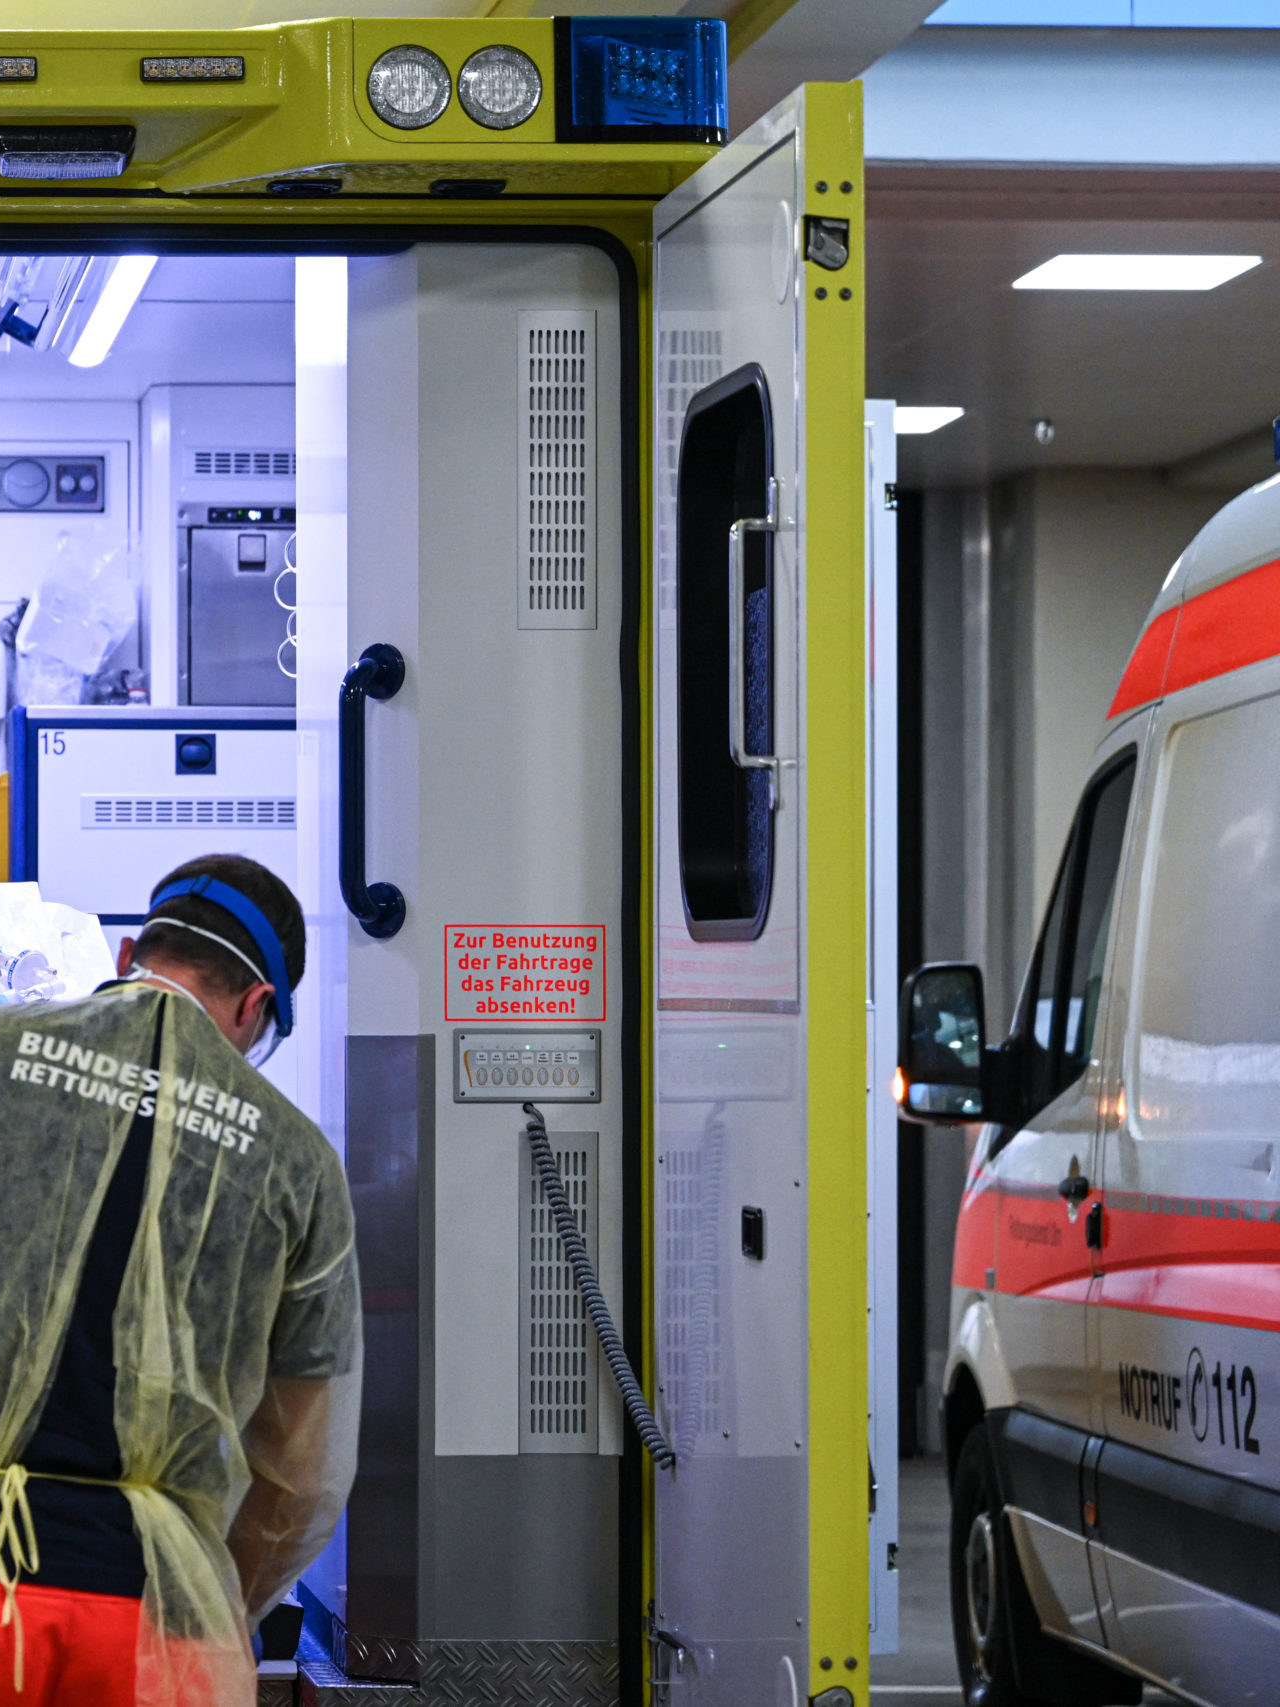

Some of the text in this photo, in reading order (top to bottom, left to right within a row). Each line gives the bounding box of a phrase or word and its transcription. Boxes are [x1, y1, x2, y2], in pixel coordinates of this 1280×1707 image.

[40, 731, 66, 755] 15
[453, 932, 597, 952] Zur Benutzung
[458, 952, 593, 973] der Fahrtrage
[461, 974, 590, 995] das Fahrzeug
[476, 996, 576, 1014] absenken!
[18, 1030, 262, 1132] BUNDESWEHR
[10, 1059, 255, 1154] RETTUNGSDIENST
[1119, 1360, 1260, 1456] NOTRUF 112
